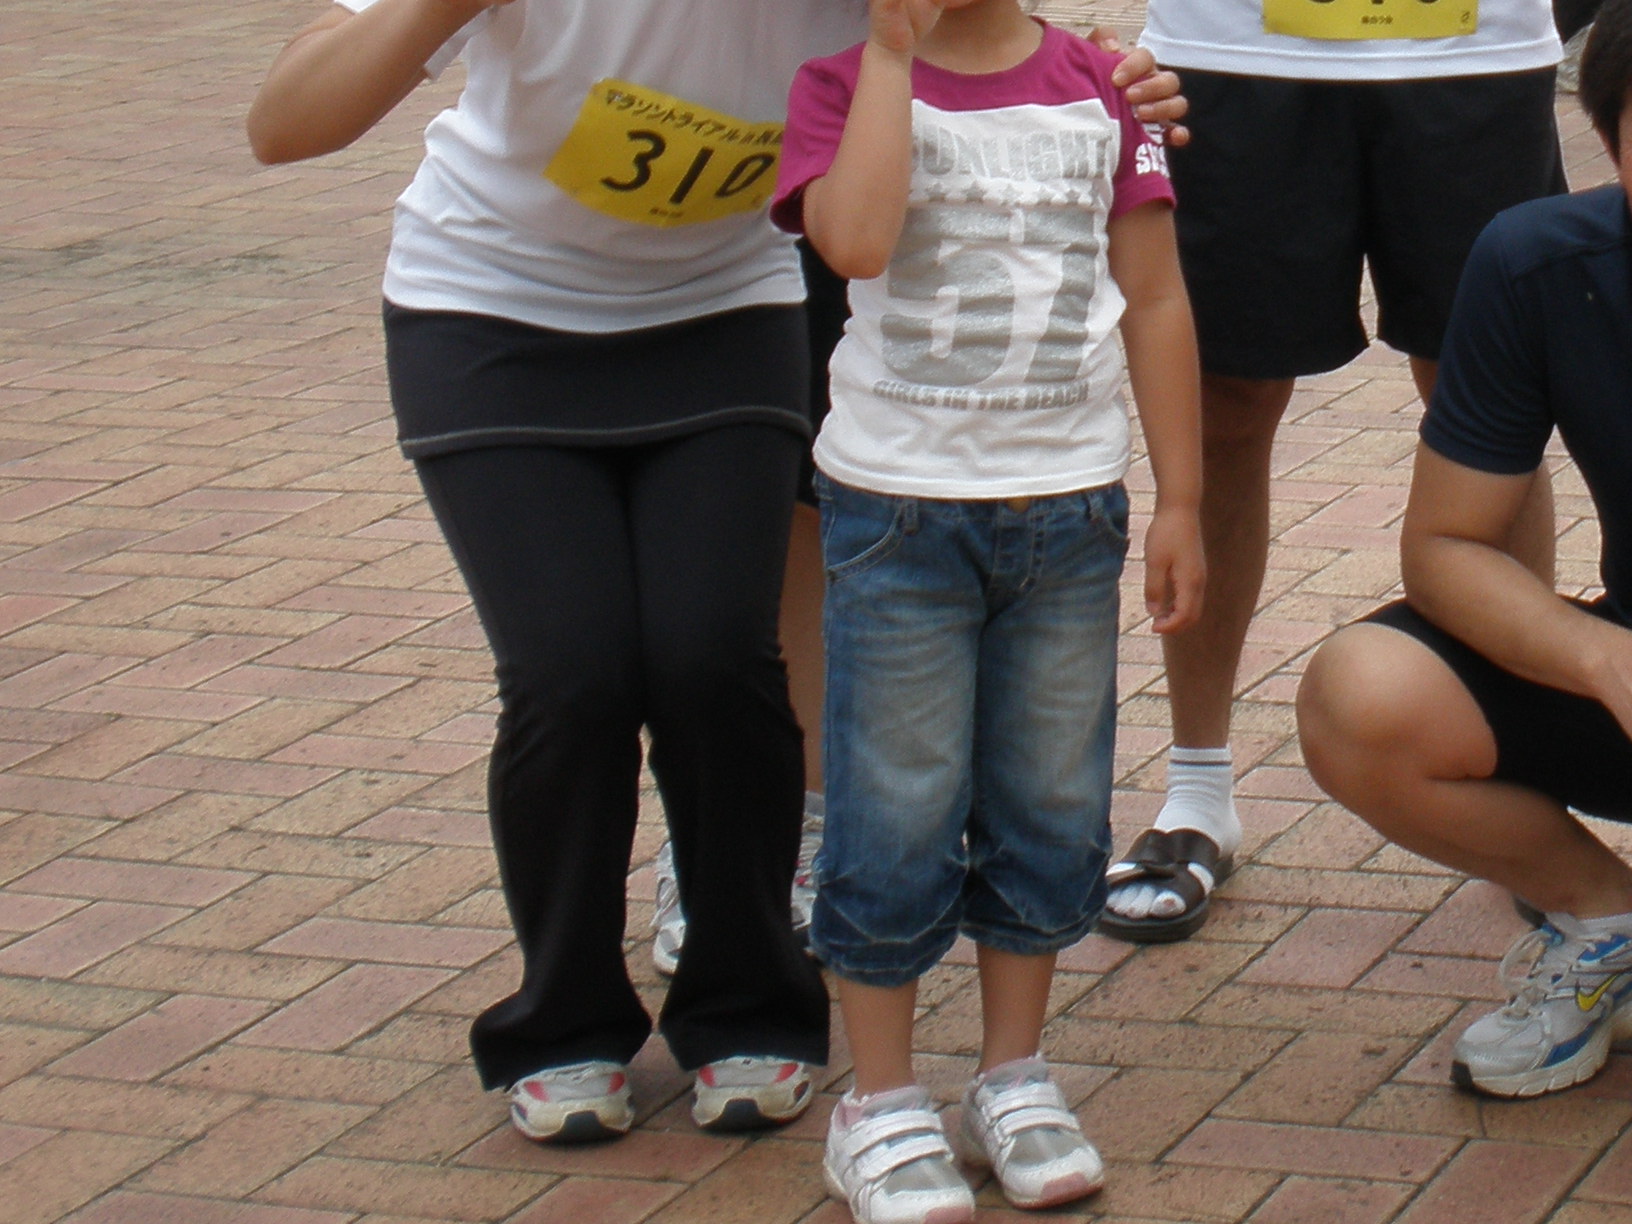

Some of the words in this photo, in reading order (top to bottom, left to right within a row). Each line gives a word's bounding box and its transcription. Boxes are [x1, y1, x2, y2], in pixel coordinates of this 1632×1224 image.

[600, 129, 775, 205] 310
[911, 123, 1113, 182] UNLIGHT
[879, 208, 1101, 386] 57
